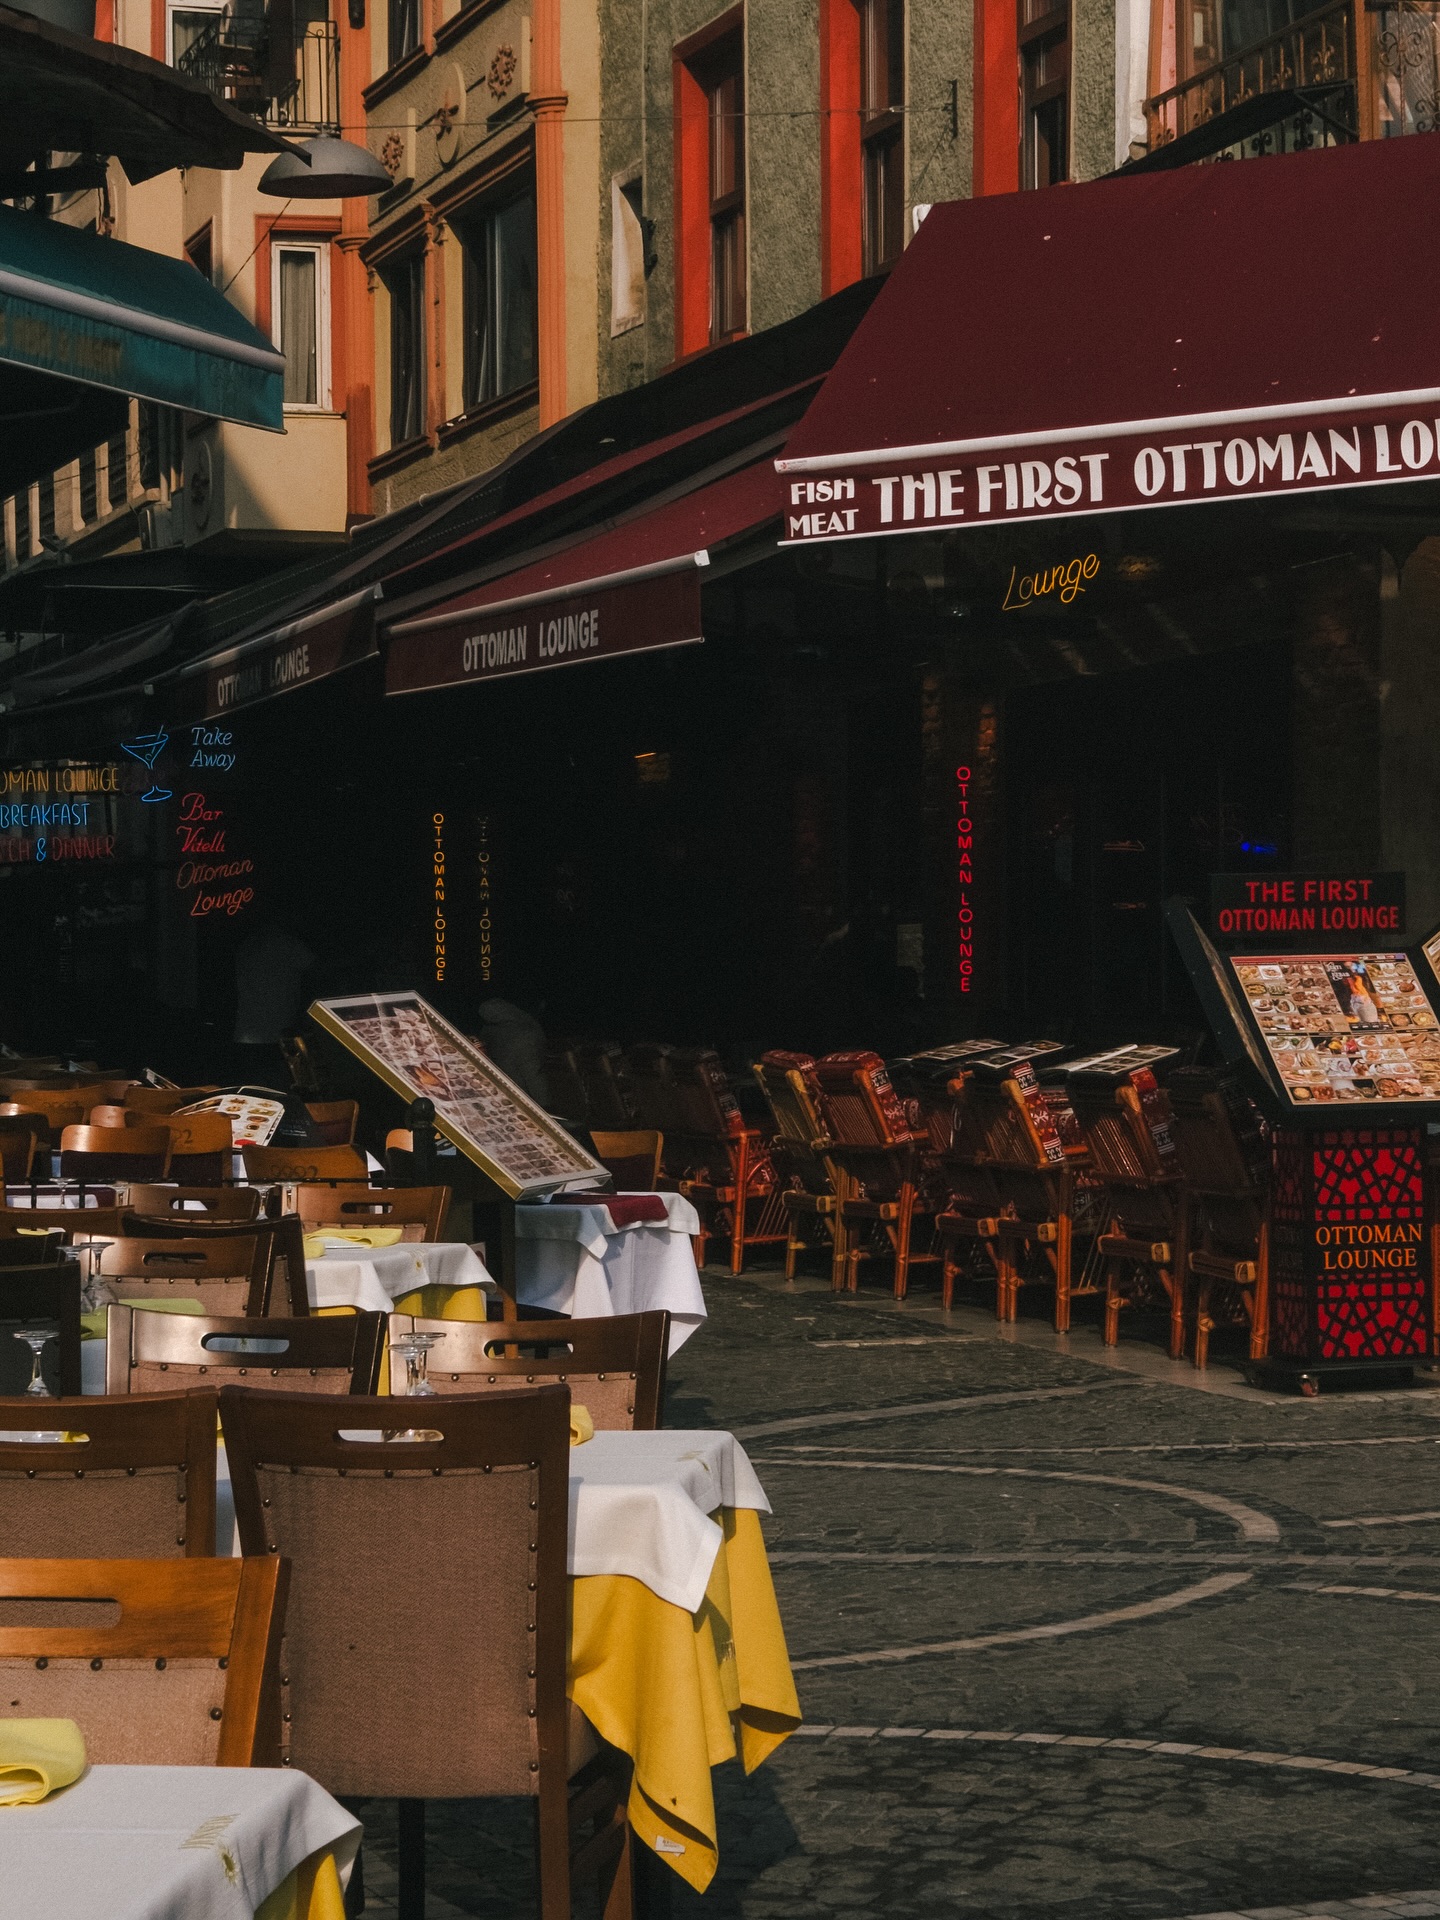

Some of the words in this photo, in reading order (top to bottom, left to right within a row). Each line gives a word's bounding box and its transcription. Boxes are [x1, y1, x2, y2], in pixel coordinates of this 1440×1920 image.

[872, 470, 964, 523] THE
[977, 453, 1109, 513] FIRST
[1134, 426, 1361, 497] OTTOMAN
[1373, 419, 1440, 473] LO
[790, 478, 855, 505] FISH
[789, 508, 859, 538] MEAT
[1002, 553, 1101, 611] Lounge
[462, 625, 528, 672] OTTOMAN
[538, 609, 599, 658] LOUNGE
[269, 643, 310, 688] LOUNGE
[191, 726, 233, 746] Take
[189, 749, 236, 772] Away
[55, 767, 119, 793] LOUNGE
[0, 802, 90, 829] BREAKFAST
[179, 792, 224, 821] Bar
[955, 765, 973, 884] OTTOMAN
[35, 837, 48, 862] &
[51, 835, 116, 861] DINNER
[432, 812, 446, 901] OTTOMAN
[176, 858, 254, 890] Ottoman
[190, 886, 255, 917] Lounge
[1246, 880, 1296, 903] THE
[1303, 879, 1373, 901] FIRST
[1218, 908, 1316, 932] OTTOMAN
[1321, 906, 1399, 930] LOUNGE
[434, 904, 447, 982] LOUNGE
[958, 892, 974, 993] LOUNGE
[1314, 1223, 1424, 1246] OTTOMAN
[1323, 1247, 1418, 1271] LOUNGE
